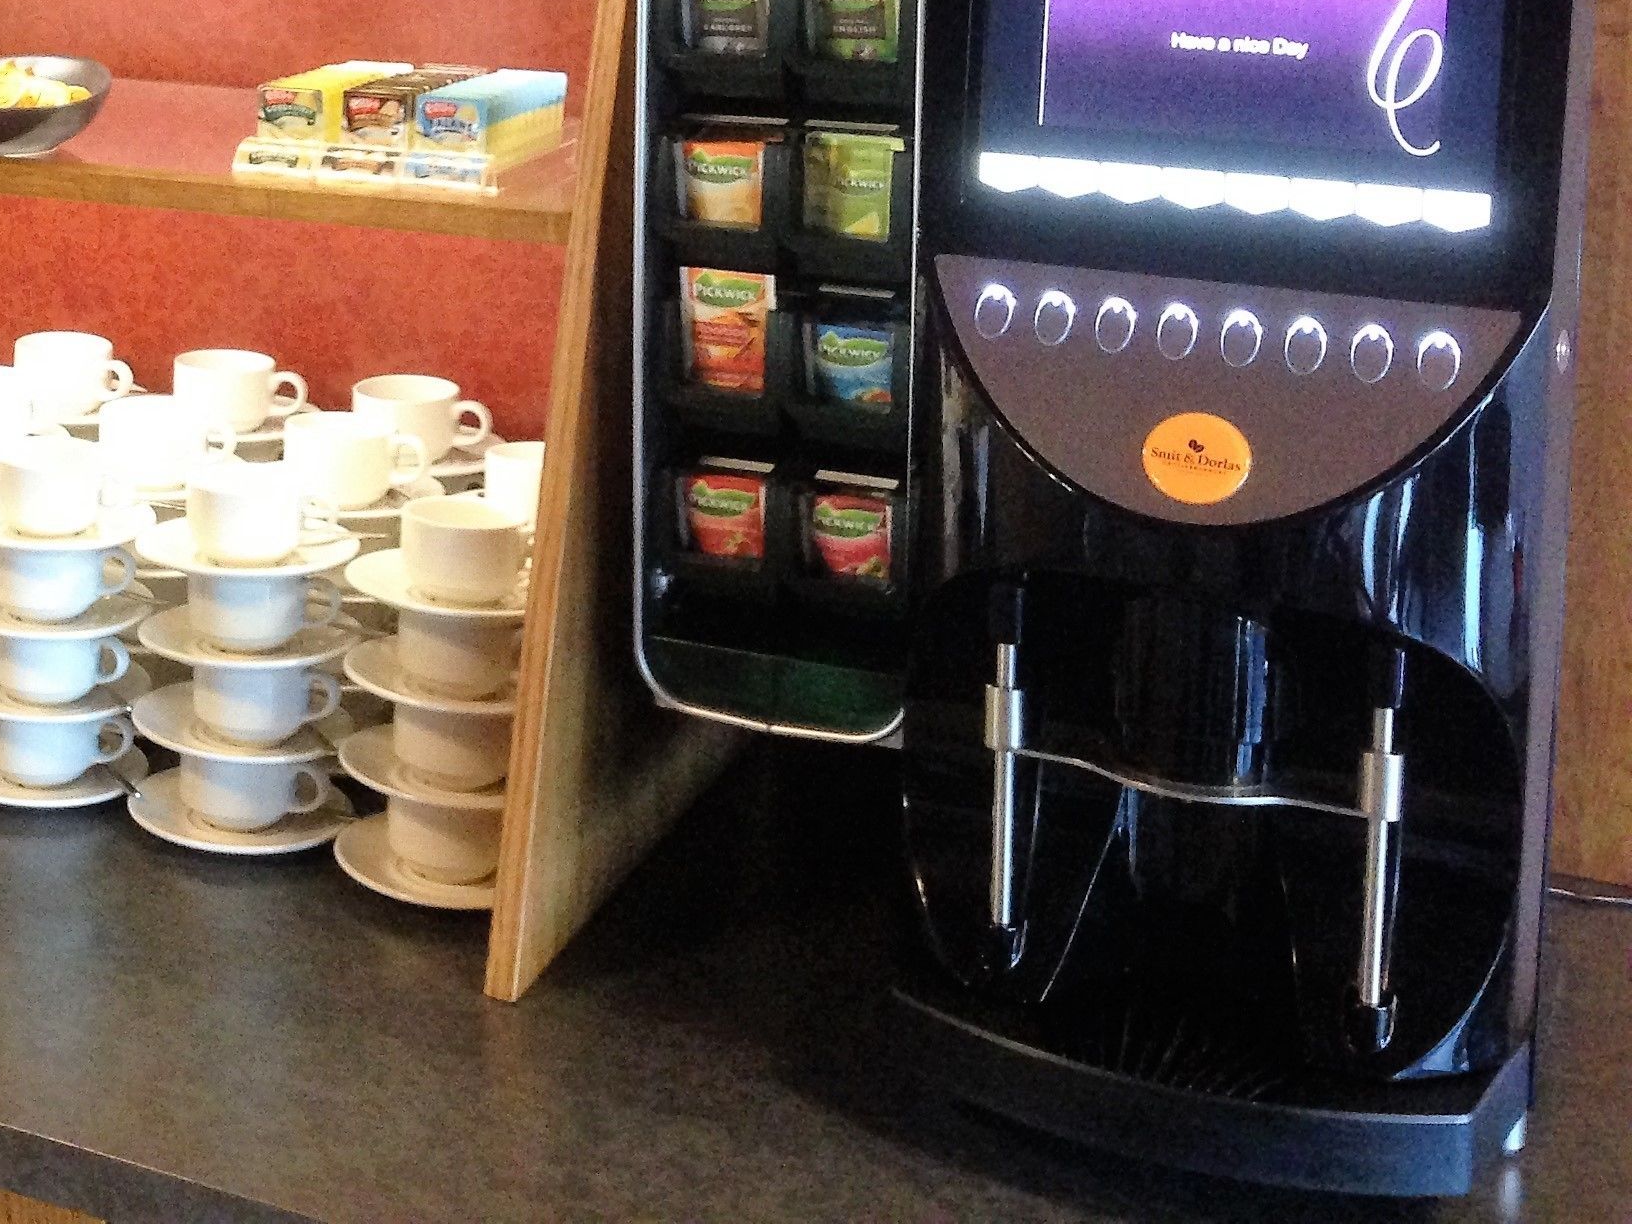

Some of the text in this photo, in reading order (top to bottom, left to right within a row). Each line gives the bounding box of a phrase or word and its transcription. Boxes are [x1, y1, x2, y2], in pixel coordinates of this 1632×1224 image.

[1171, 32, 1309, 60] Have a nice Day
[1151, 447, 1180, 462] Smit
[1183, 455, 1195, 465] &
[1198, 454, 1241, 471] Dorlas
